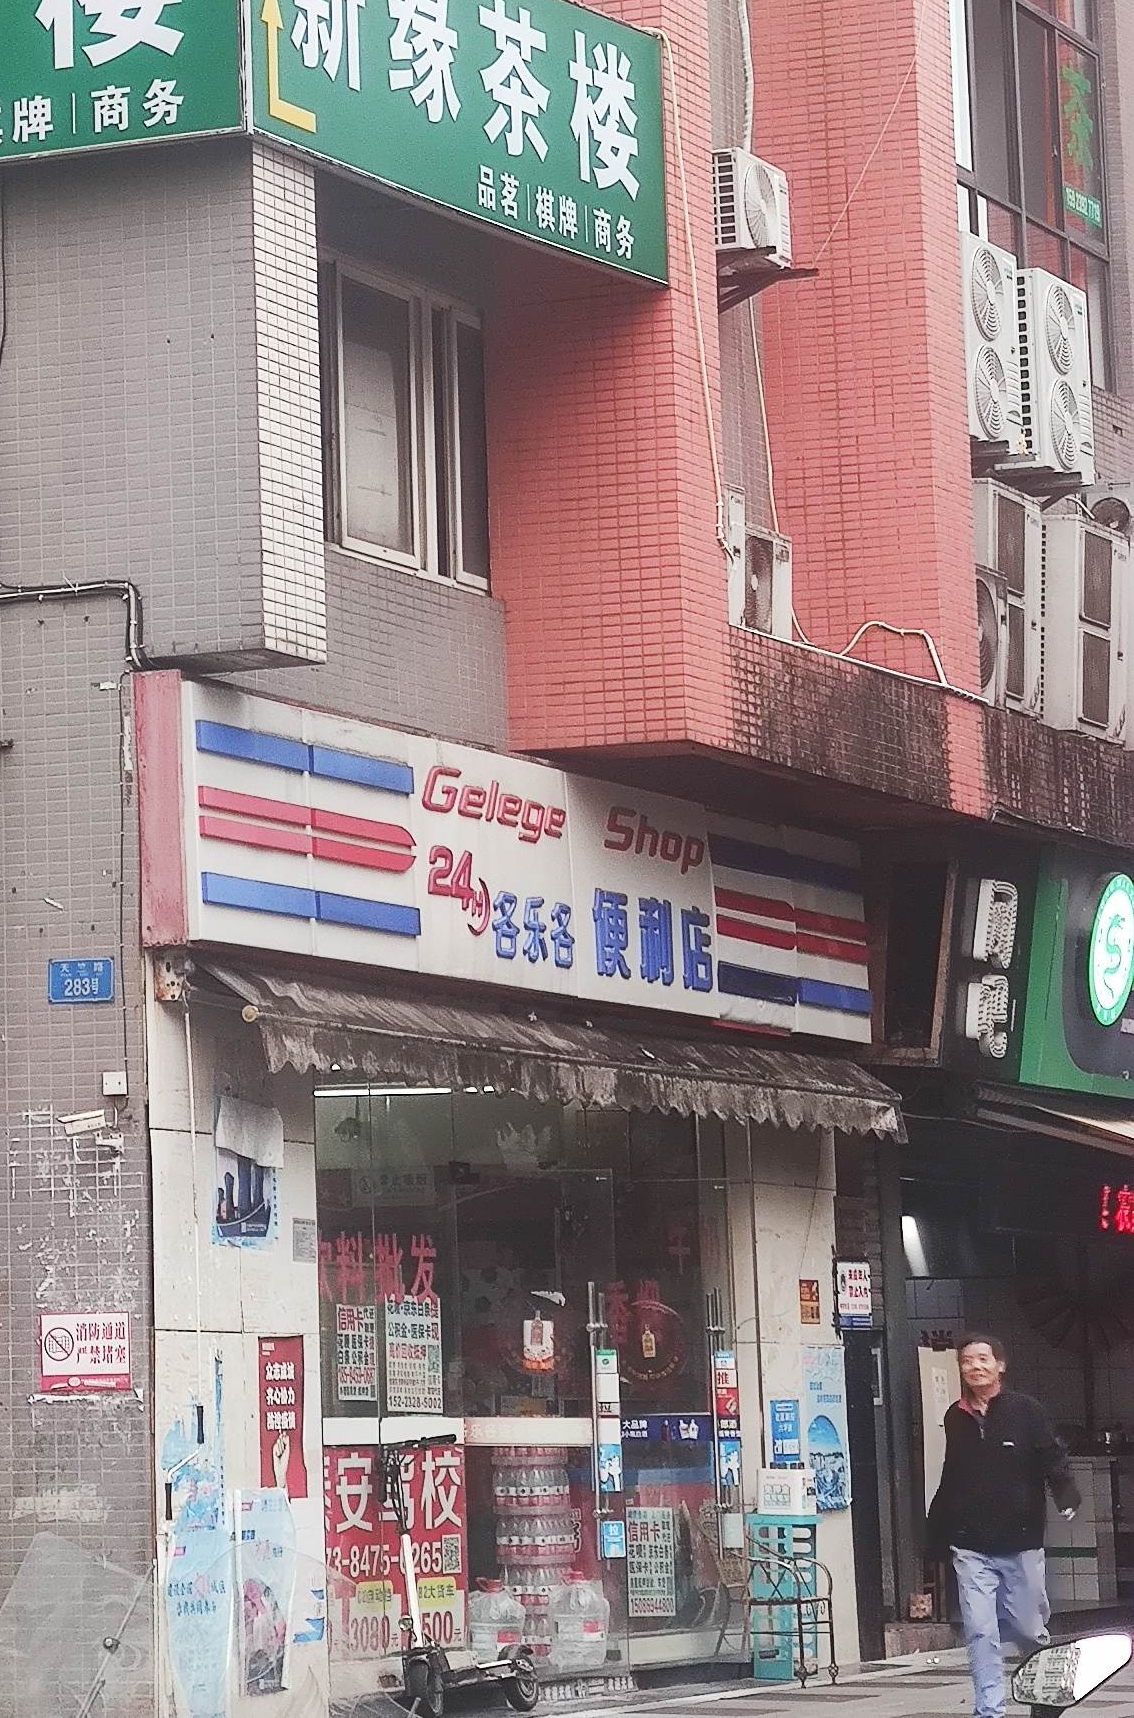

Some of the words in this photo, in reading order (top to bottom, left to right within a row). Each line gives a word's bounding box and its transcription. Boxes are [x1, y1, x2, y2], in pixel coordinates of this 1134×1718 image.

[91, 76, 186, 133] 商务
[476, 163, 520, 221] 品茗
[534, 185, 579, 242] 棋牌
[593, 207, 636, 261] 商务
[421, 764, 567, 844] Gelege
[603, 805, 706, 876] Shop
[591, 887, 714, 994] 便利店
[63, 976, 99, 998] 283号
[75, 1321, 126, 1341] 消防通道
[338, 1306, 364, 1332] 信用卡
[76, 1344, 126, 1364] 严禁堵塞
[717, 1371, 730, 1385] 推
[628, 1520, 661, 1543] 信用卡
[417, 1610, 463, 1645] 500元
